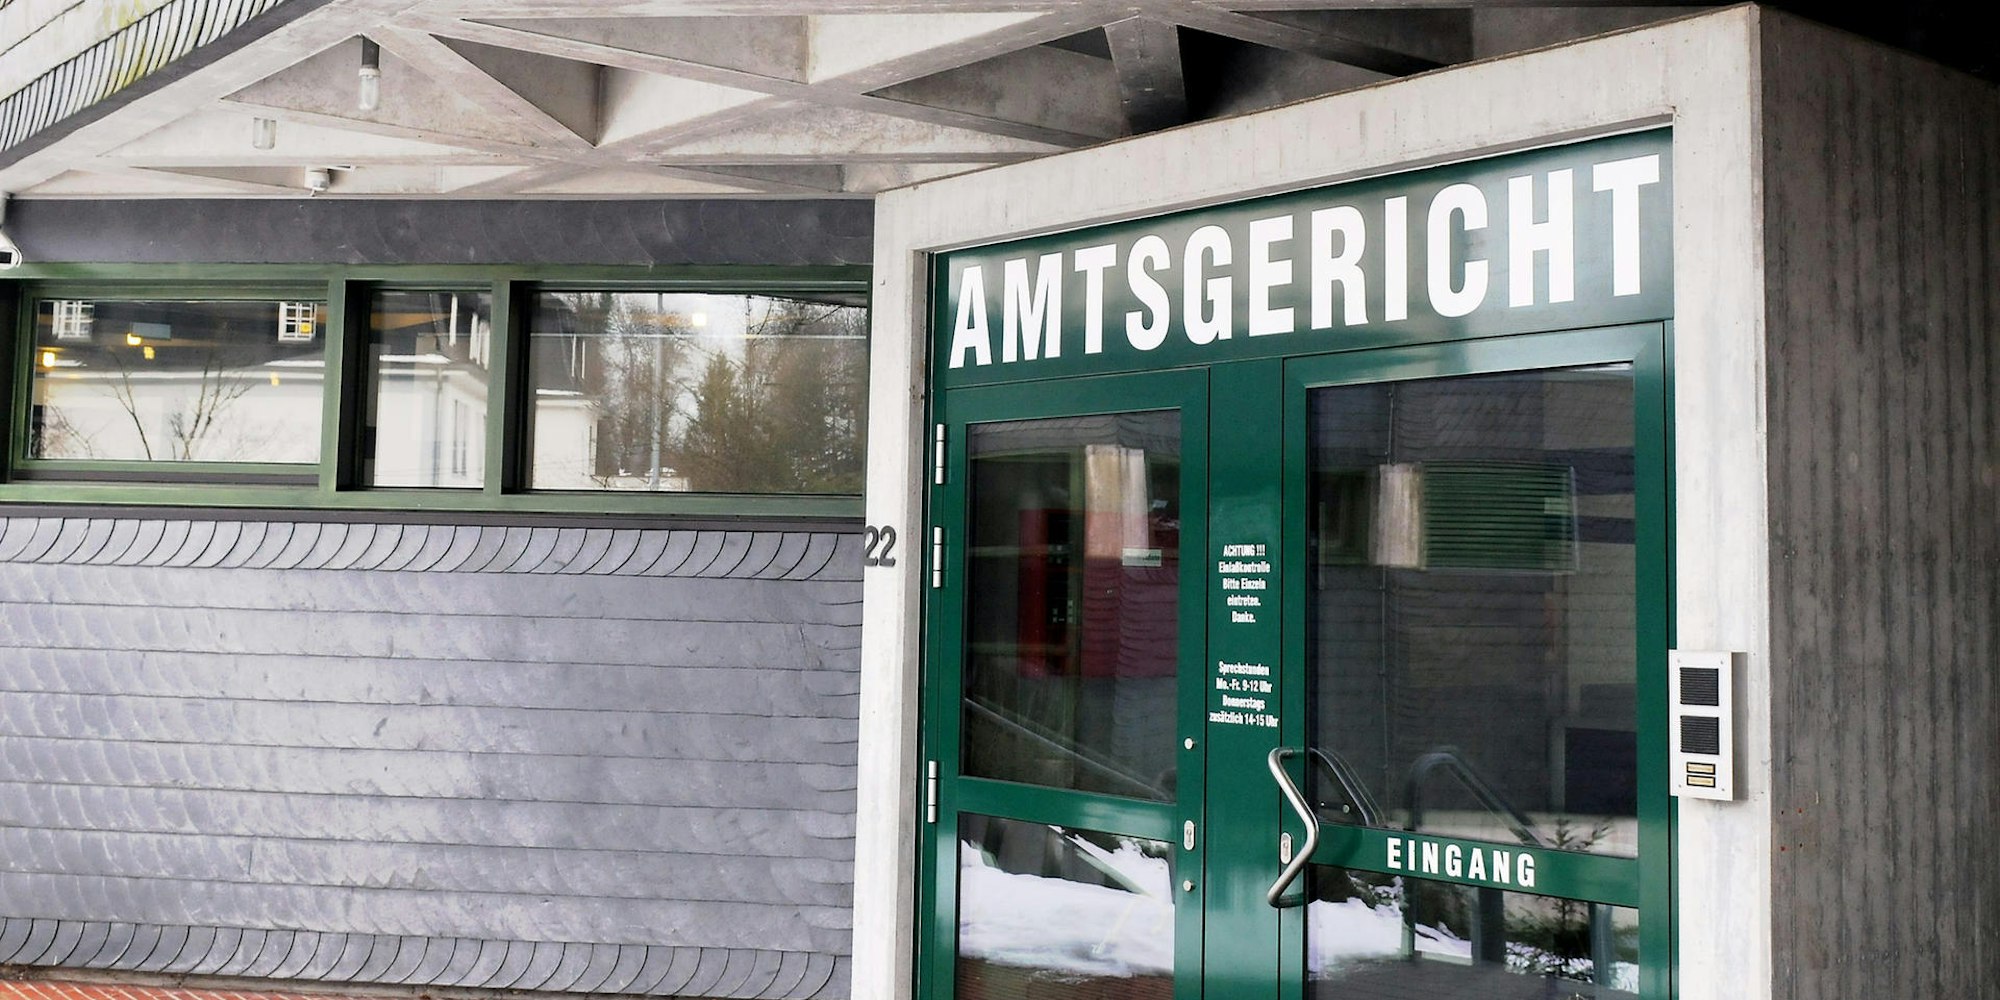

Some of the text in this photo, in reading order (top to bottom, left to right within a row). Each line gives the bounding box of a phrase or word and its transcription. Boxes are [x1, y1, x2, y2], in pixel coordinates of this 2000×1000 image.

[949, 153, 1660, 369] AMTSGERICHT
[863, 525, 896, 567] 22
[1223, 544, 1265, 556] ACHTUNG !!!
[1222, 577, 1266, 590] Bitte Einzeln
[1227, 594, 1261, 606] eintreten.
[1232, 610, 1255, 623] Danke.
[1219, 661, 1270, 676] Sprechstunden
[1216, 677, 1272, 693] Mo.-Fr. 9-12 Uhr
[1222, 694, 1265, 711] Donnerstags
[1209, 710, 1279, 728] zusätzlich 14-15 Uhr
[1387, 837, 1535, 888] EINGANG
